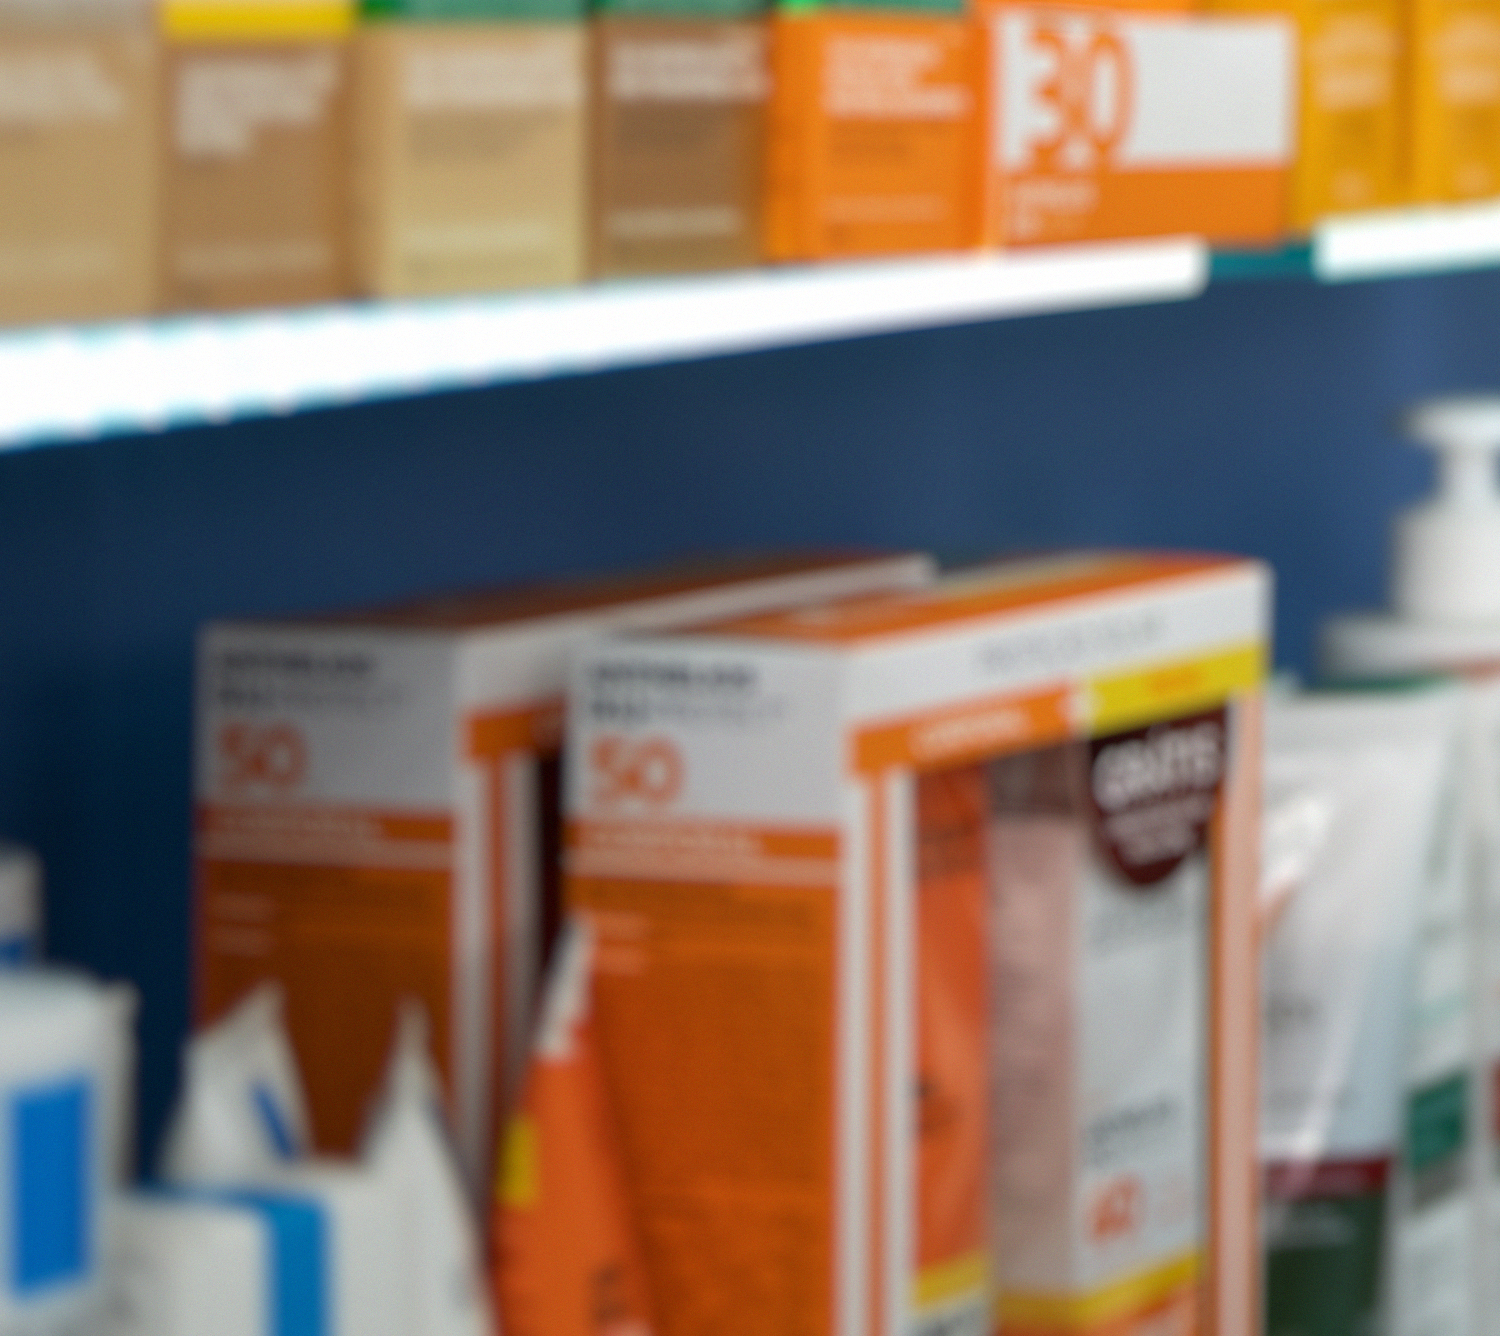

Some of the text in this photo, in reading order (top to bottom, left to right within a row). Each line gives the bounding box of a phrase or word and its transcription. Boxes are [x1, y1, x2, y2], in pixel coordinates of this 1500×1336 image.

[1024, 23, 1134, 166] 30
[217, 722, 306, 792] 50
[590, 738, 683, 807] 50
